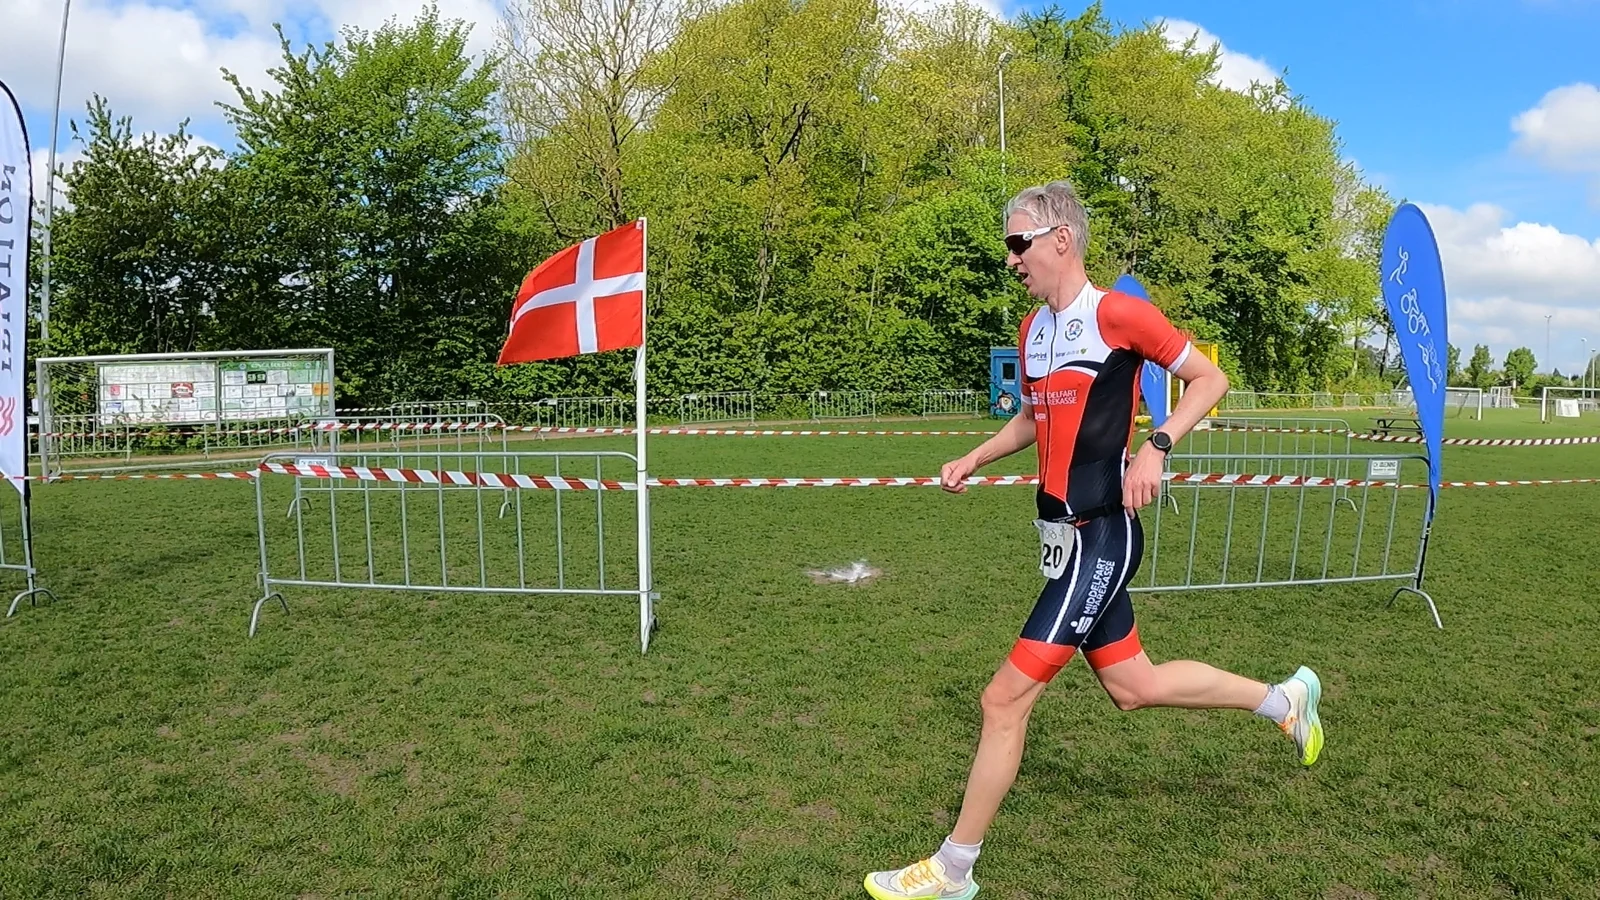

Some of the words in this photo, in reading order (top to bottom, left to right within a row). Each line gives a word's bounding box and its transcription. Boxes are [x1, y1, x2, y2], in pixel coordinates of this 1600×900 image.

[1042, 543, 1063, 569] 20
[1083, 557, 1107, 615] MIDDELFART
[1090, 561, 1115, 615] SPAREKASSE
